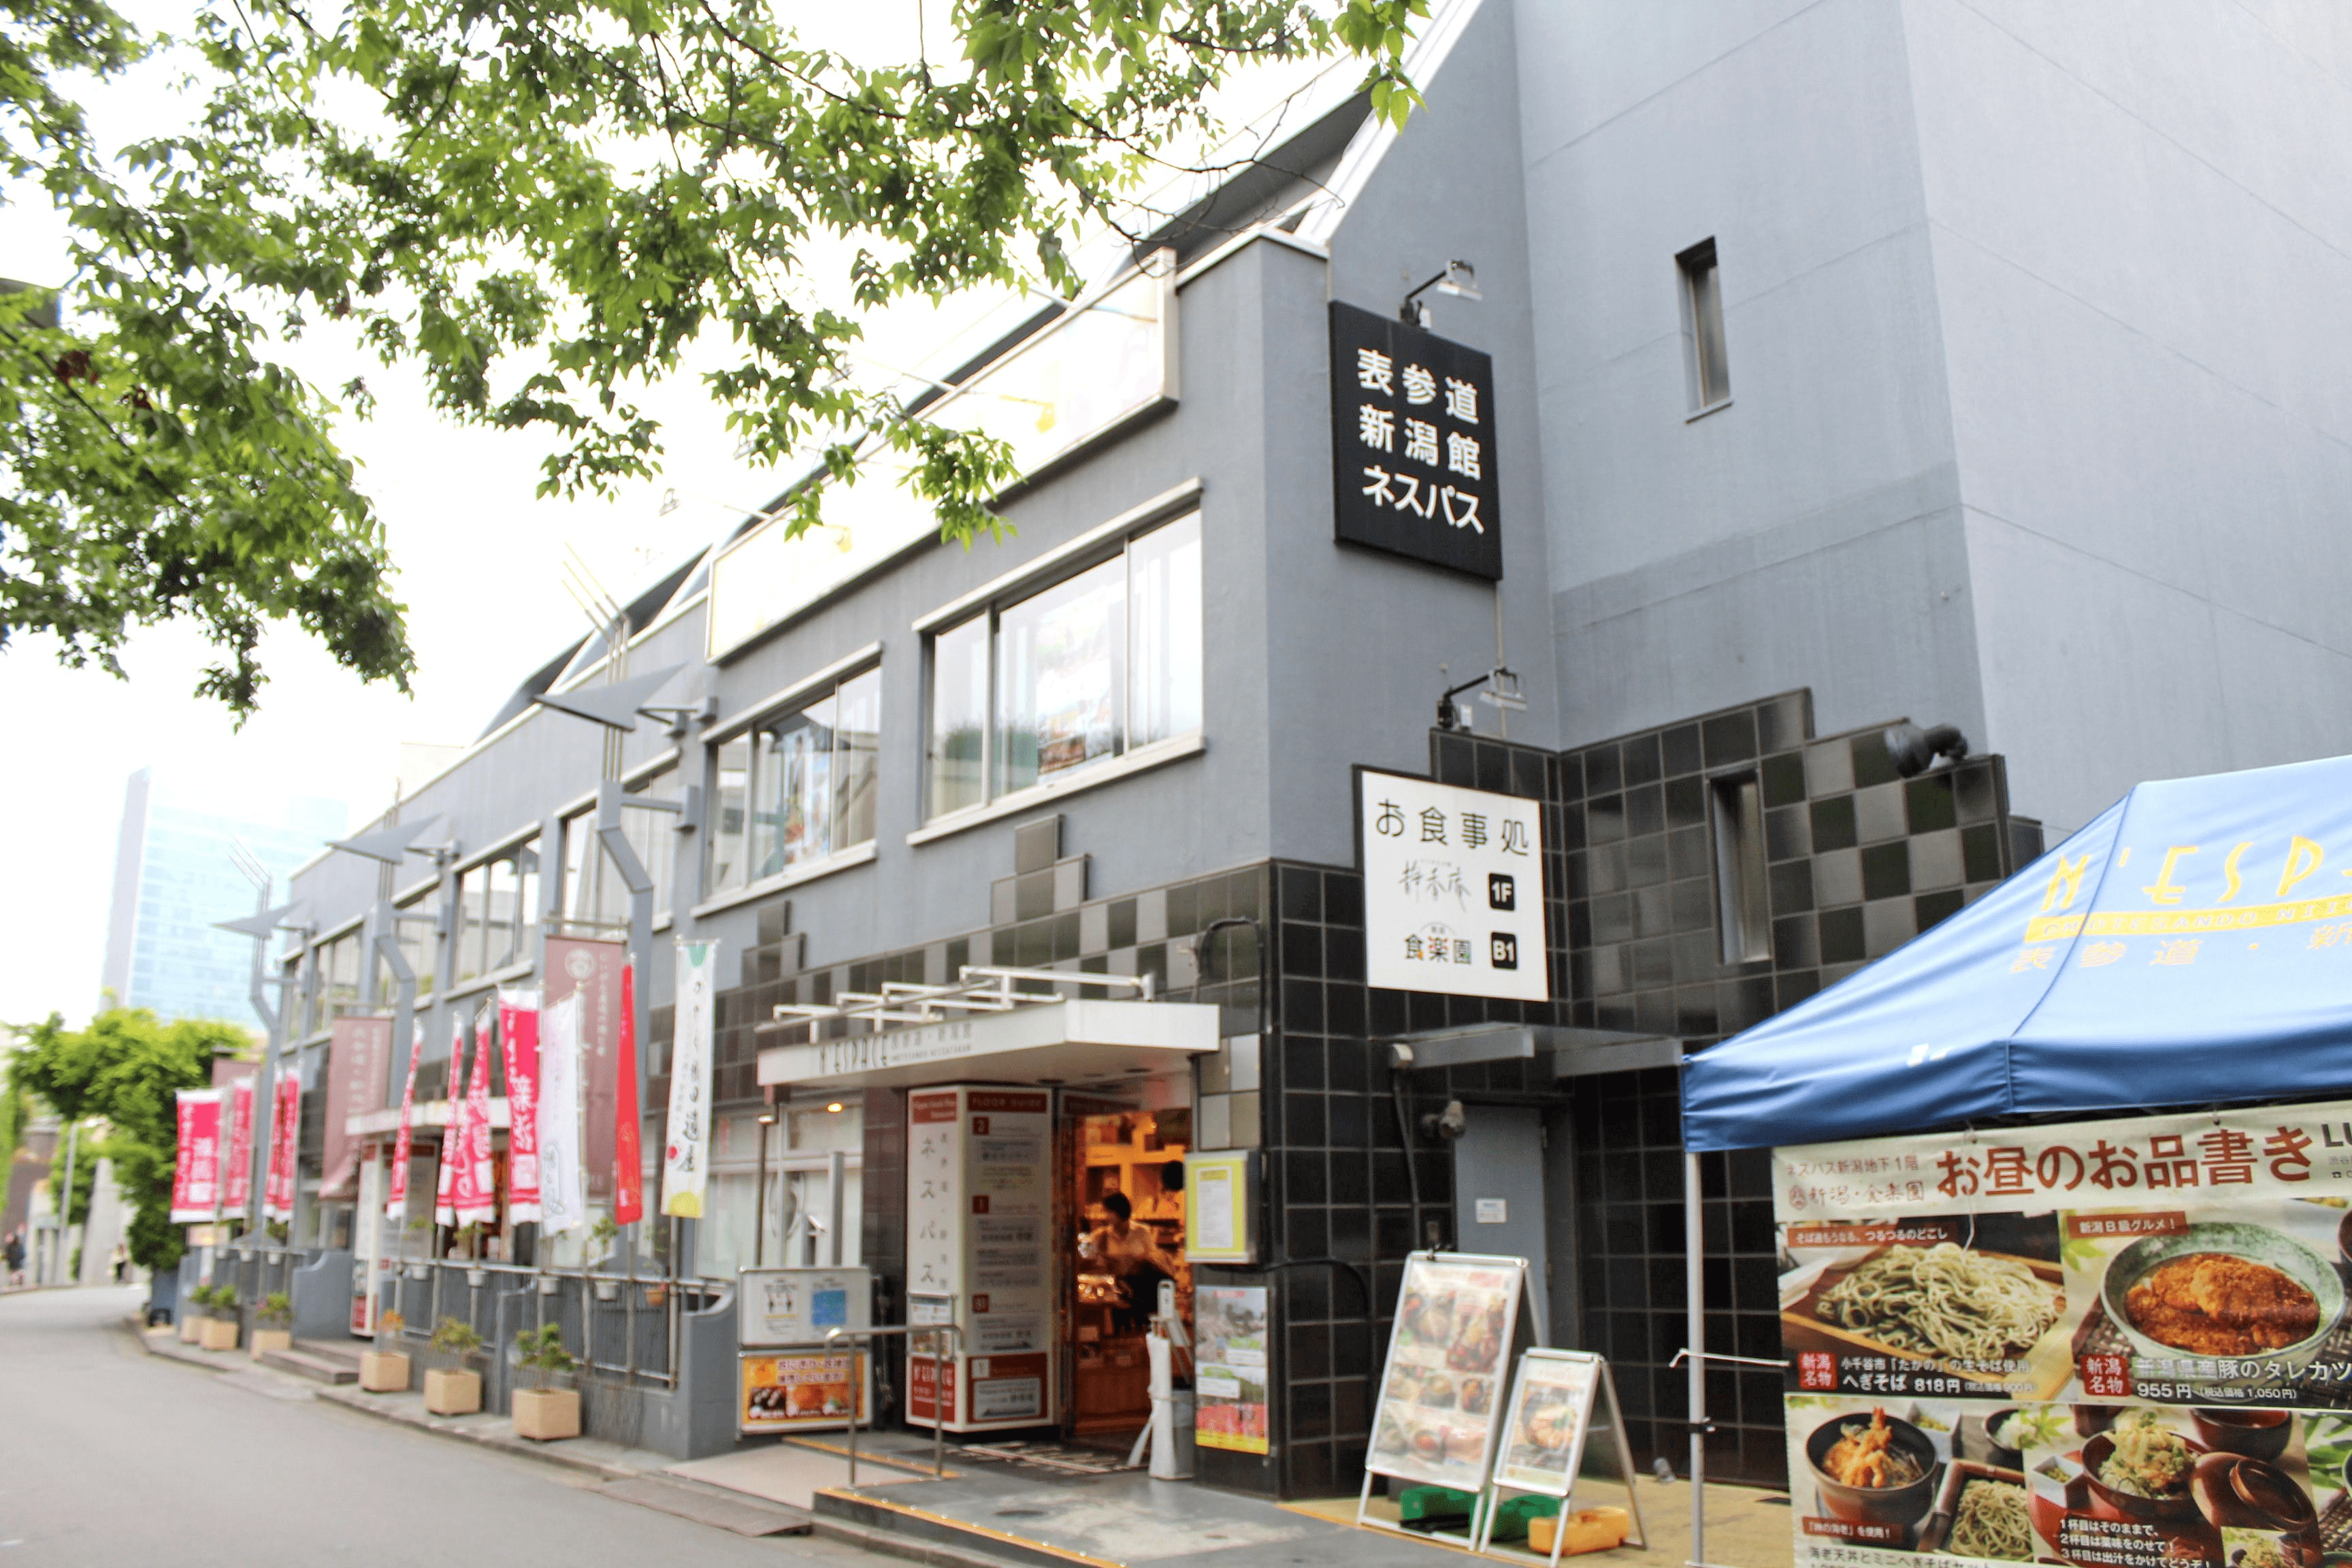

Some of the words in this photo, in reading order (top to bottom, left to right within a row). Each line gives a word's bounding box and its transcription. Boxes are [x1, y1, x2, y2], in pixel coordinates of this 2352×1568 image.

[1357, 348, 1479, 425] 表参道
[1359, 404, 1482, 481] 新潟館
[1362, 465, 1485, 535] ネスパス
[1375, 798, 1529, 857] お食事処
[2040, 834, 2352, 913] N'ESP
[1491, 881, 1512, 903] 1F
[2044, 911, 2258, 937] OMOTESANDO
[1404, 933, 1472, 965] 食楽園
[1492, 939, 1516, 962] B1
[1936, 1125, 2313, 1198] お昼のお品書き
[1801, 1353, 1831, 1371] 新潟
[2086, 1357, 2122, 1376] 新潟
[1803, 1371, 1833, 1387] 名物
[1842, 1373, 1908, 1392] へぎそば
[1914, 1377, 1961, 1394] 818円
[2089, 1376, 2124, 1394] 名物
[2137, 1383, 2193, 1399] 955円
